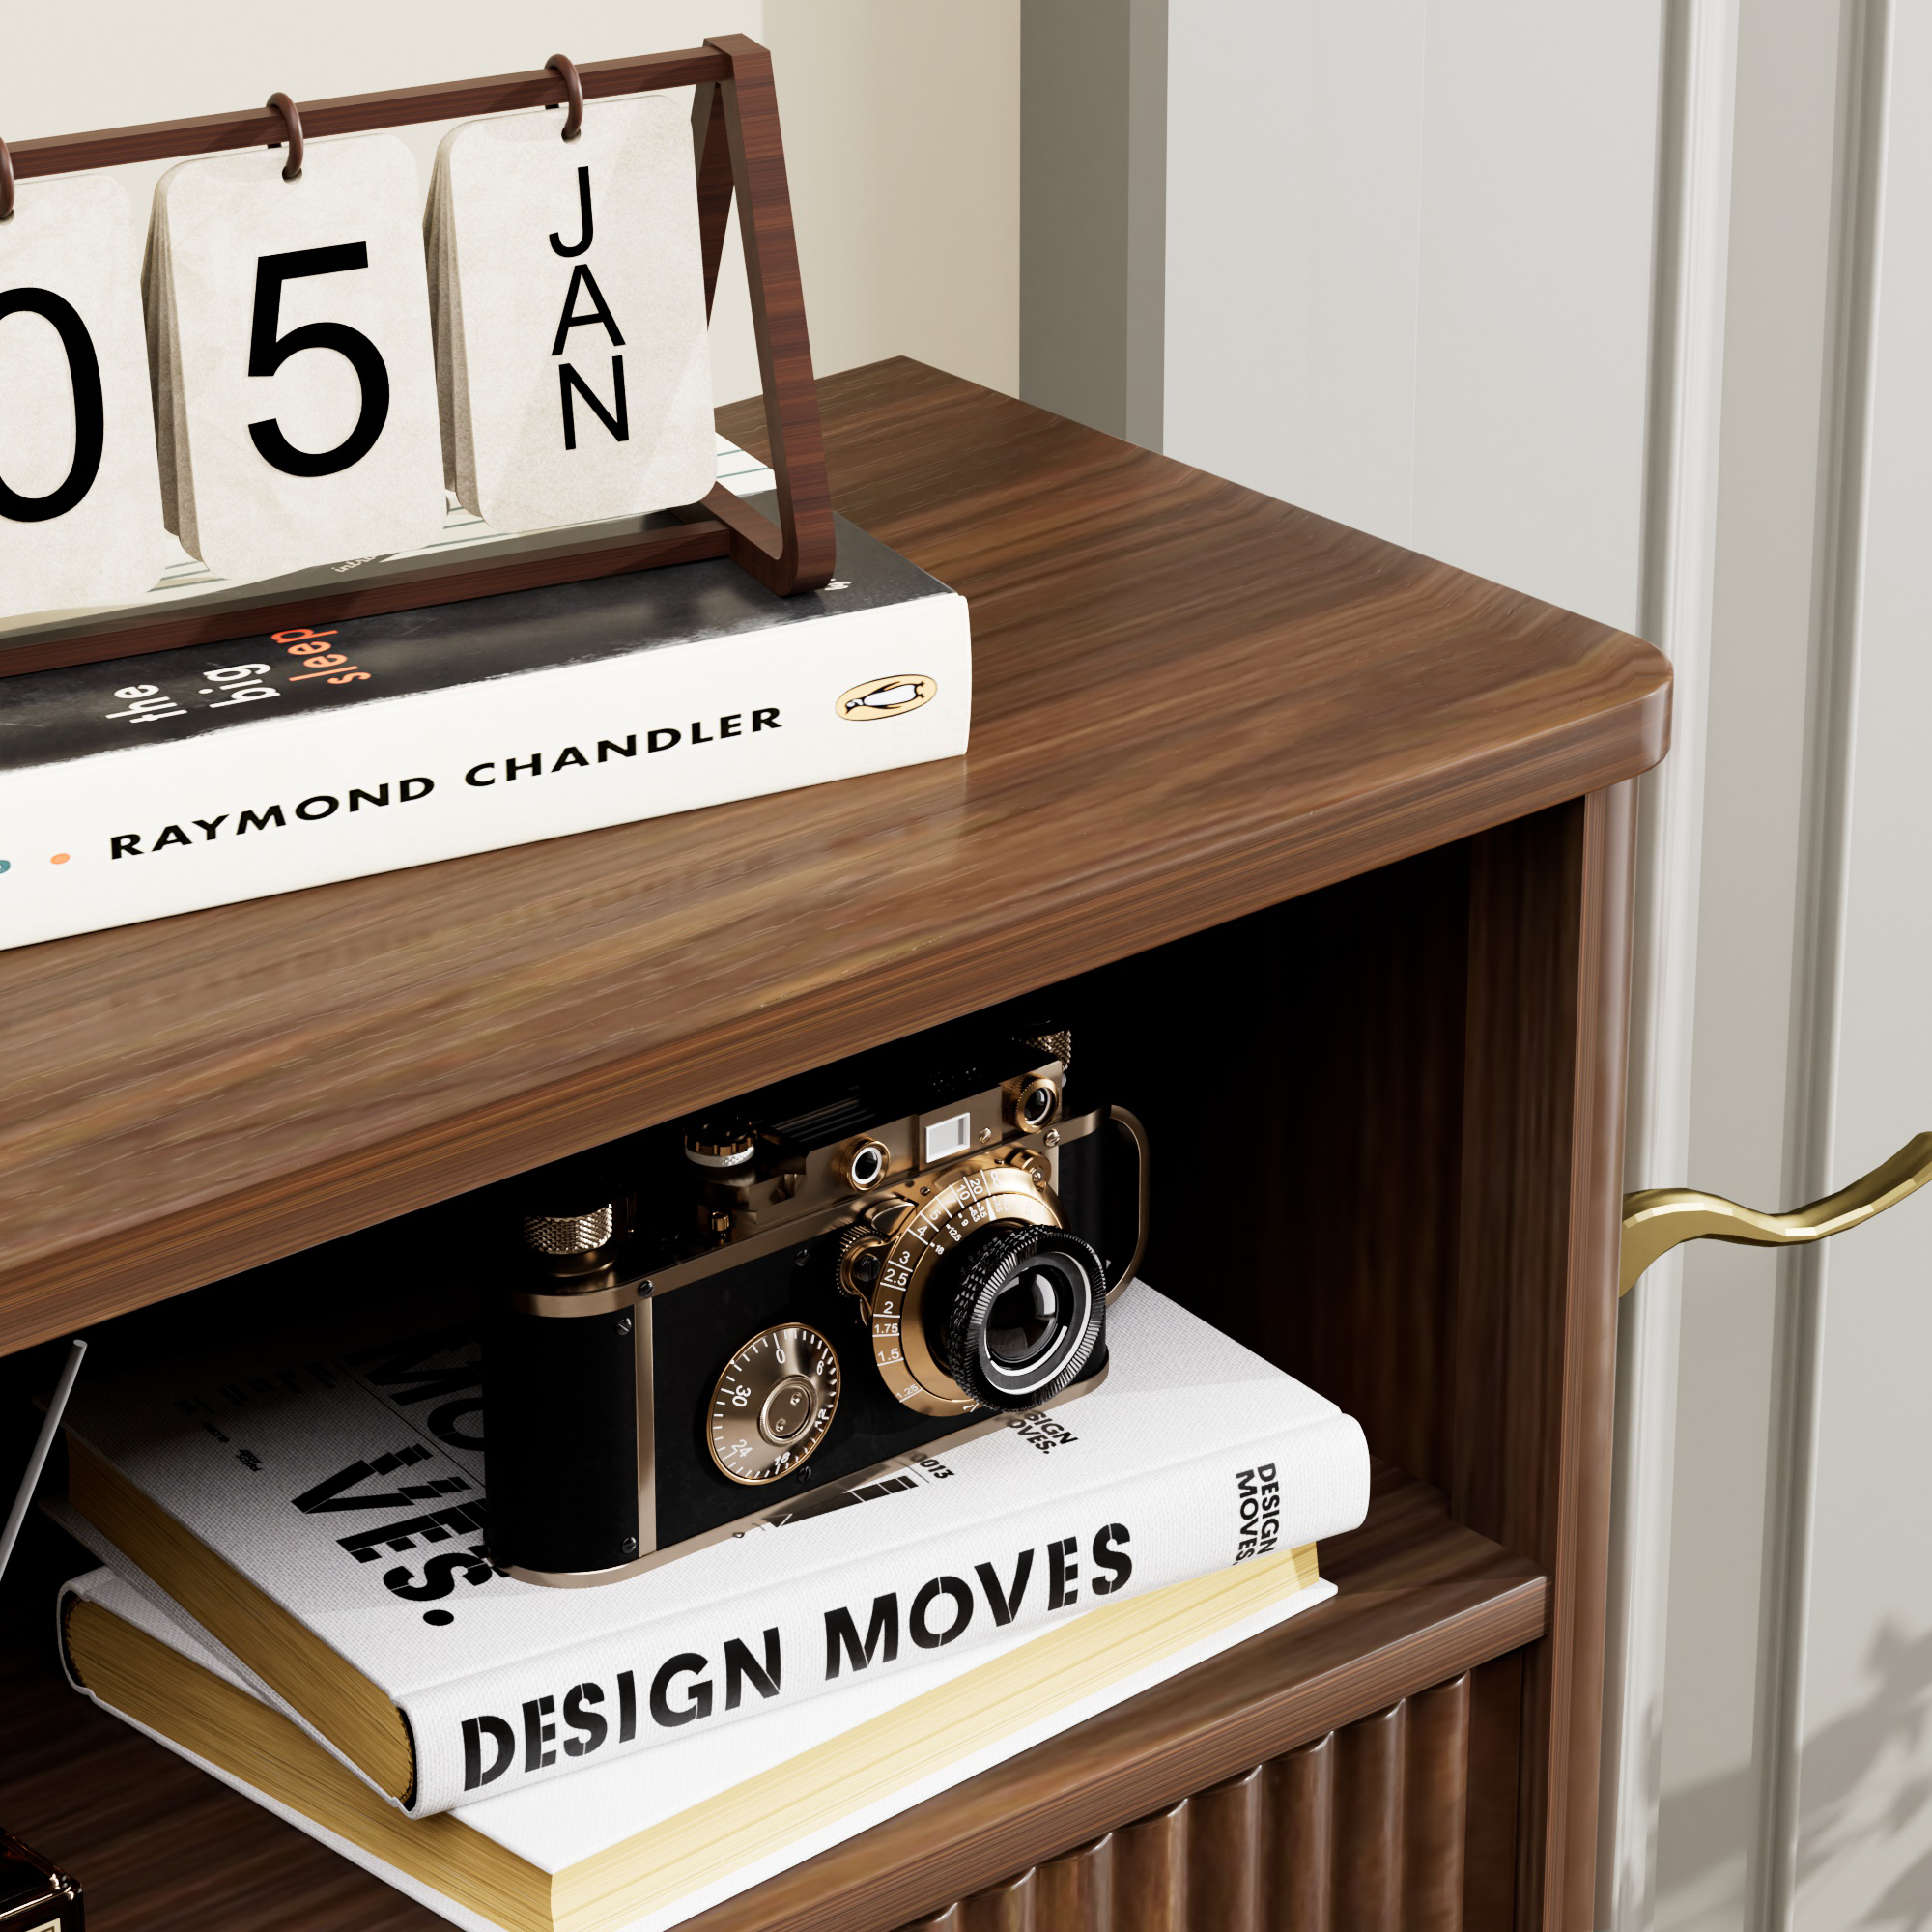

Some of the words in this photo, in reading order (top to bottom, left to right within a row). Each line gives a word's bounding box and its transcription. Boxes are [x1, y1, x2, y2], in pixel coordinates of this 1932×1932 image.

[549, 165, 630, 451] JAN
[247, 241, 390, 478] 5
[270, 628, 372, 685] sleep
[198, 663, 281, 708] big
[105, 684, 188, 724] the
[109, 776, 436, 861] RAYMOND
[465, 707, 783, 788] CHANDLER
[956, 1184, 971, 1201] 10
[969, 1178, 984, 1195] 20
[929, 1208, 941, 1221] 5
[917, 1225, 929, 1237] 4
[898, 1251, 911, 1264] 3
[883, 1268, 909, 1286] 2.5
[883, 1301, 894, 1315] 2
[874, 1323, 899, 1335] 1.75
[775, 1349, 786, 1364] 0
[877, 1348, 900, 1362] 1.5
[816, 1360, 824, 1376] 6
[731, 1384, 752, 1407] 30
[895, 1383, 919, 1400] 1.25
[1009, 1419, 1058, 1455] OVES.
[1026, 1412, 1079, 1445] SIGN
[731, 1438, 753, 1458] 24
[774, 1451, 791, 1467] 18
[1257, 1463, 1280, 1555] DESIGN
[461, 1627, 781, 1792] DESIGN
[824, 1522, 1132, 1679] MOVES
